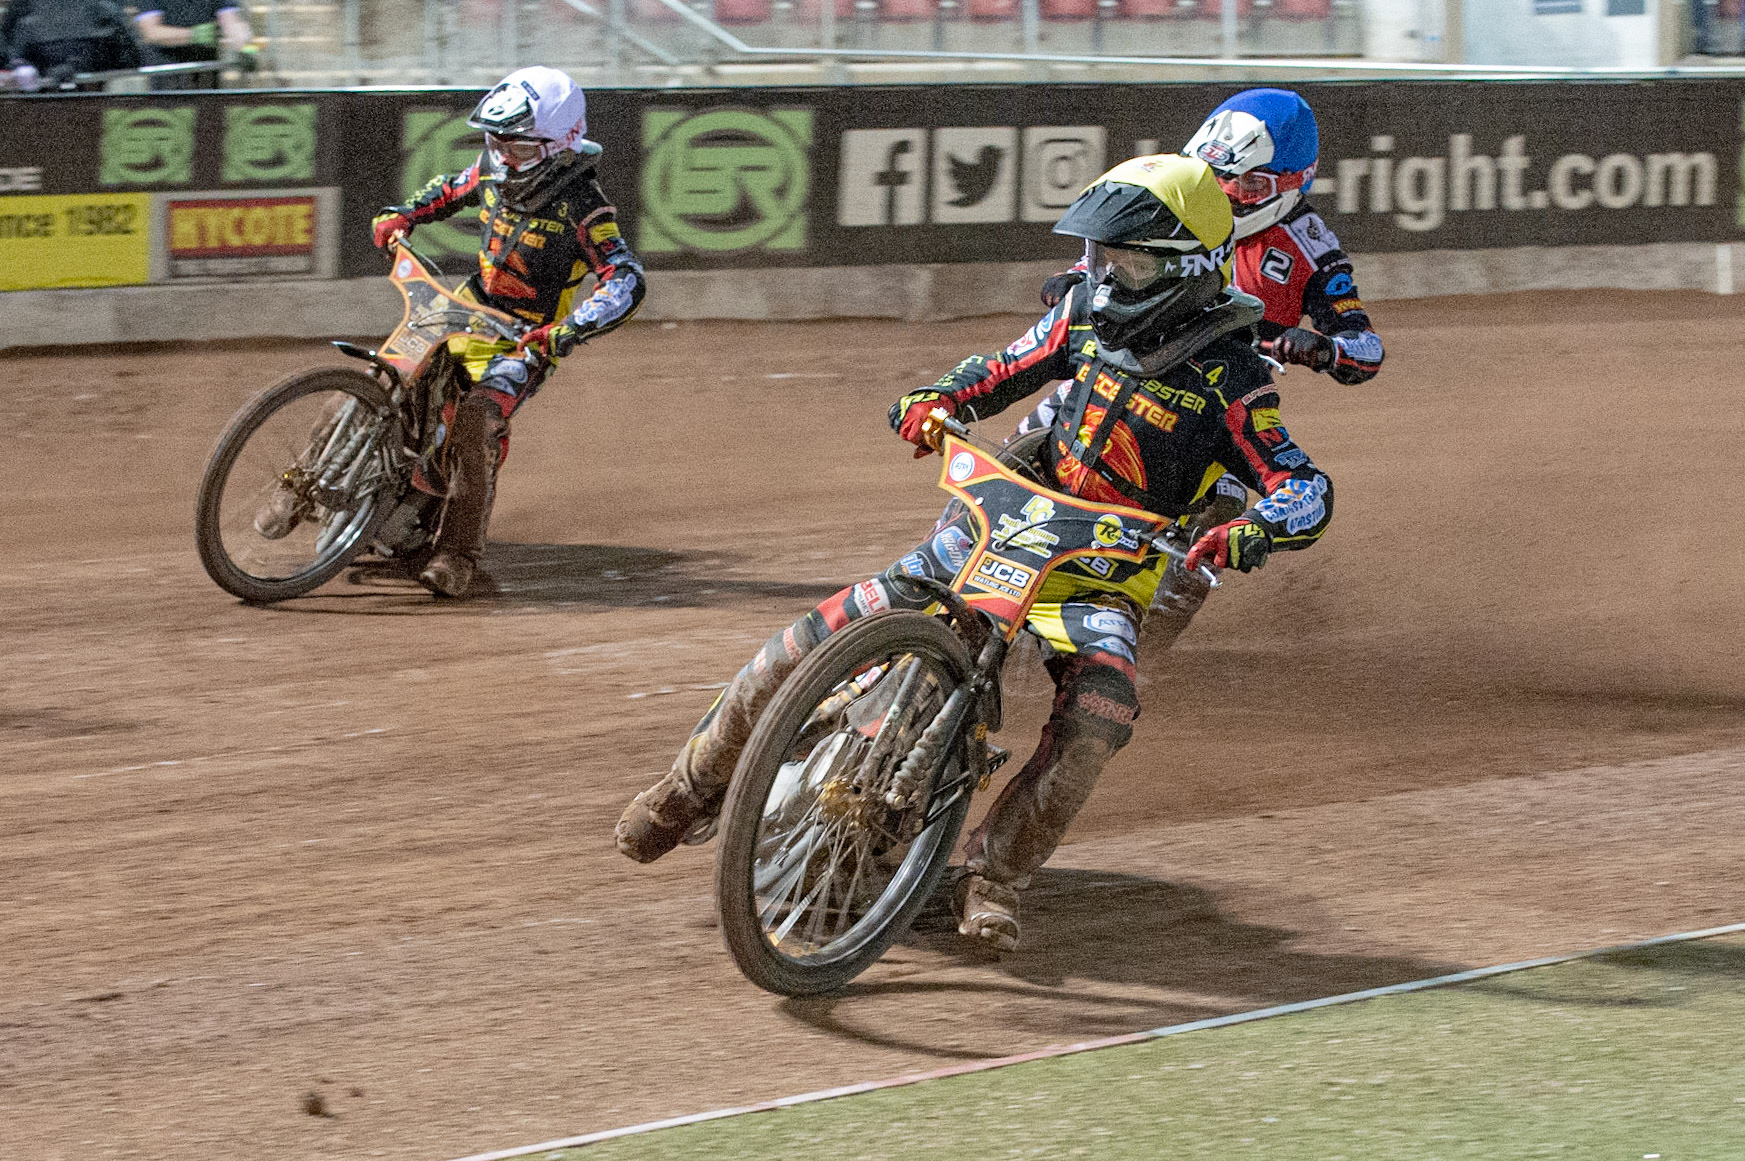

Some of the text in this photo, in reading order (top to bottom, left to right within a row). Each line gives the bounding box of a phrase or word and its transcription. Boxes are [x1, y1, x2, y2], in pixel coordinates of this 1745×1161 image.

[1263, 249, 1291, 281] 2
[1205, 365, 1224, 386] 4
[980, 561, 1031, 588] JCB
